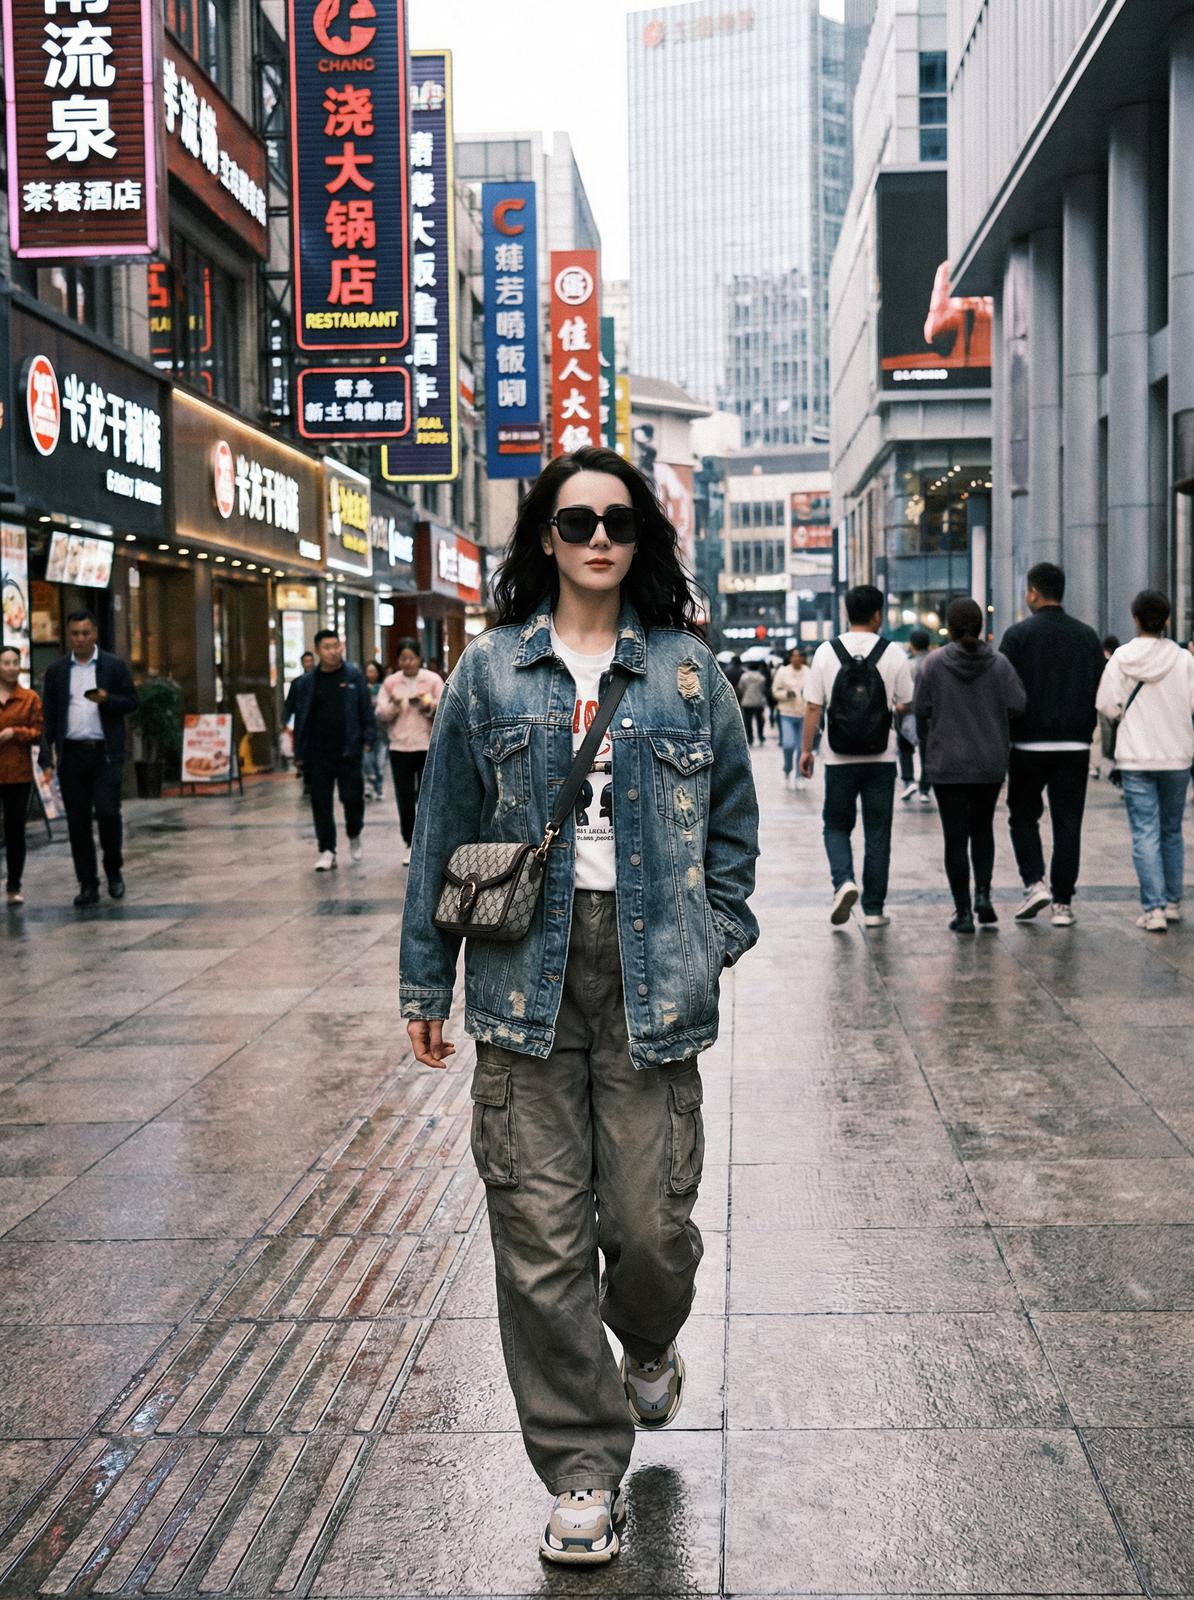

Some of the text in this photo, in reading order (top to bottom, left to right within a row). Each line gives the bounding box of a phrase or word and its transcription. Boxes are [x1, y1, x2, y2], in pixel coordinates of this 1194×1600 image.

[41, 0, 118, 162] 流泉
[23, 179, 142, 213] 茶餐酒店
[323, 84, 377, 306] 浇大锅店
[305, 310, 399, 330] RESTAURANT
